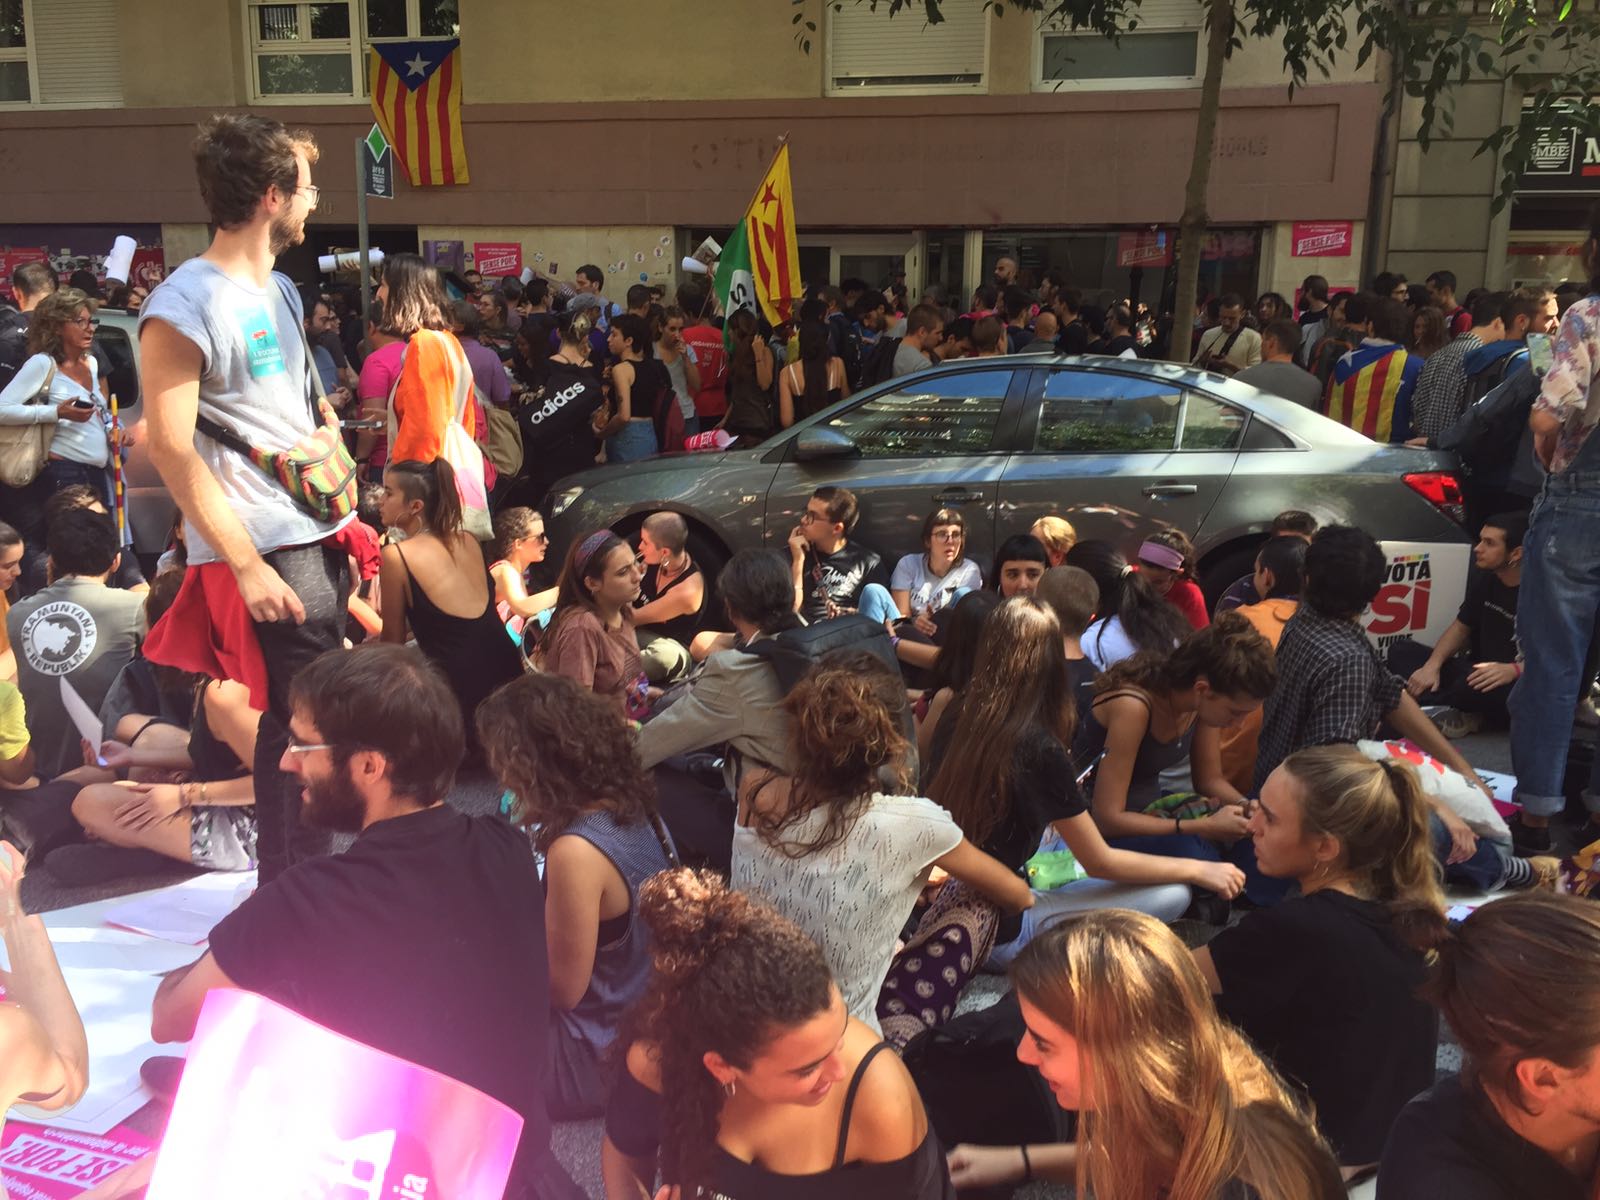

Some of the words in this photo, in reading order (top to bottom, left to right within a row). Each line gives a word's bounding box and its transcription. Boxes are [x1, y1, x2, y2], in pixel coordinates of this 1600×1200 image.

[1535, 146, 1567, 157] MBE
[531, 382, 585, 424] adidas
[23, 604, 95, 642] TRAMUNTANA
